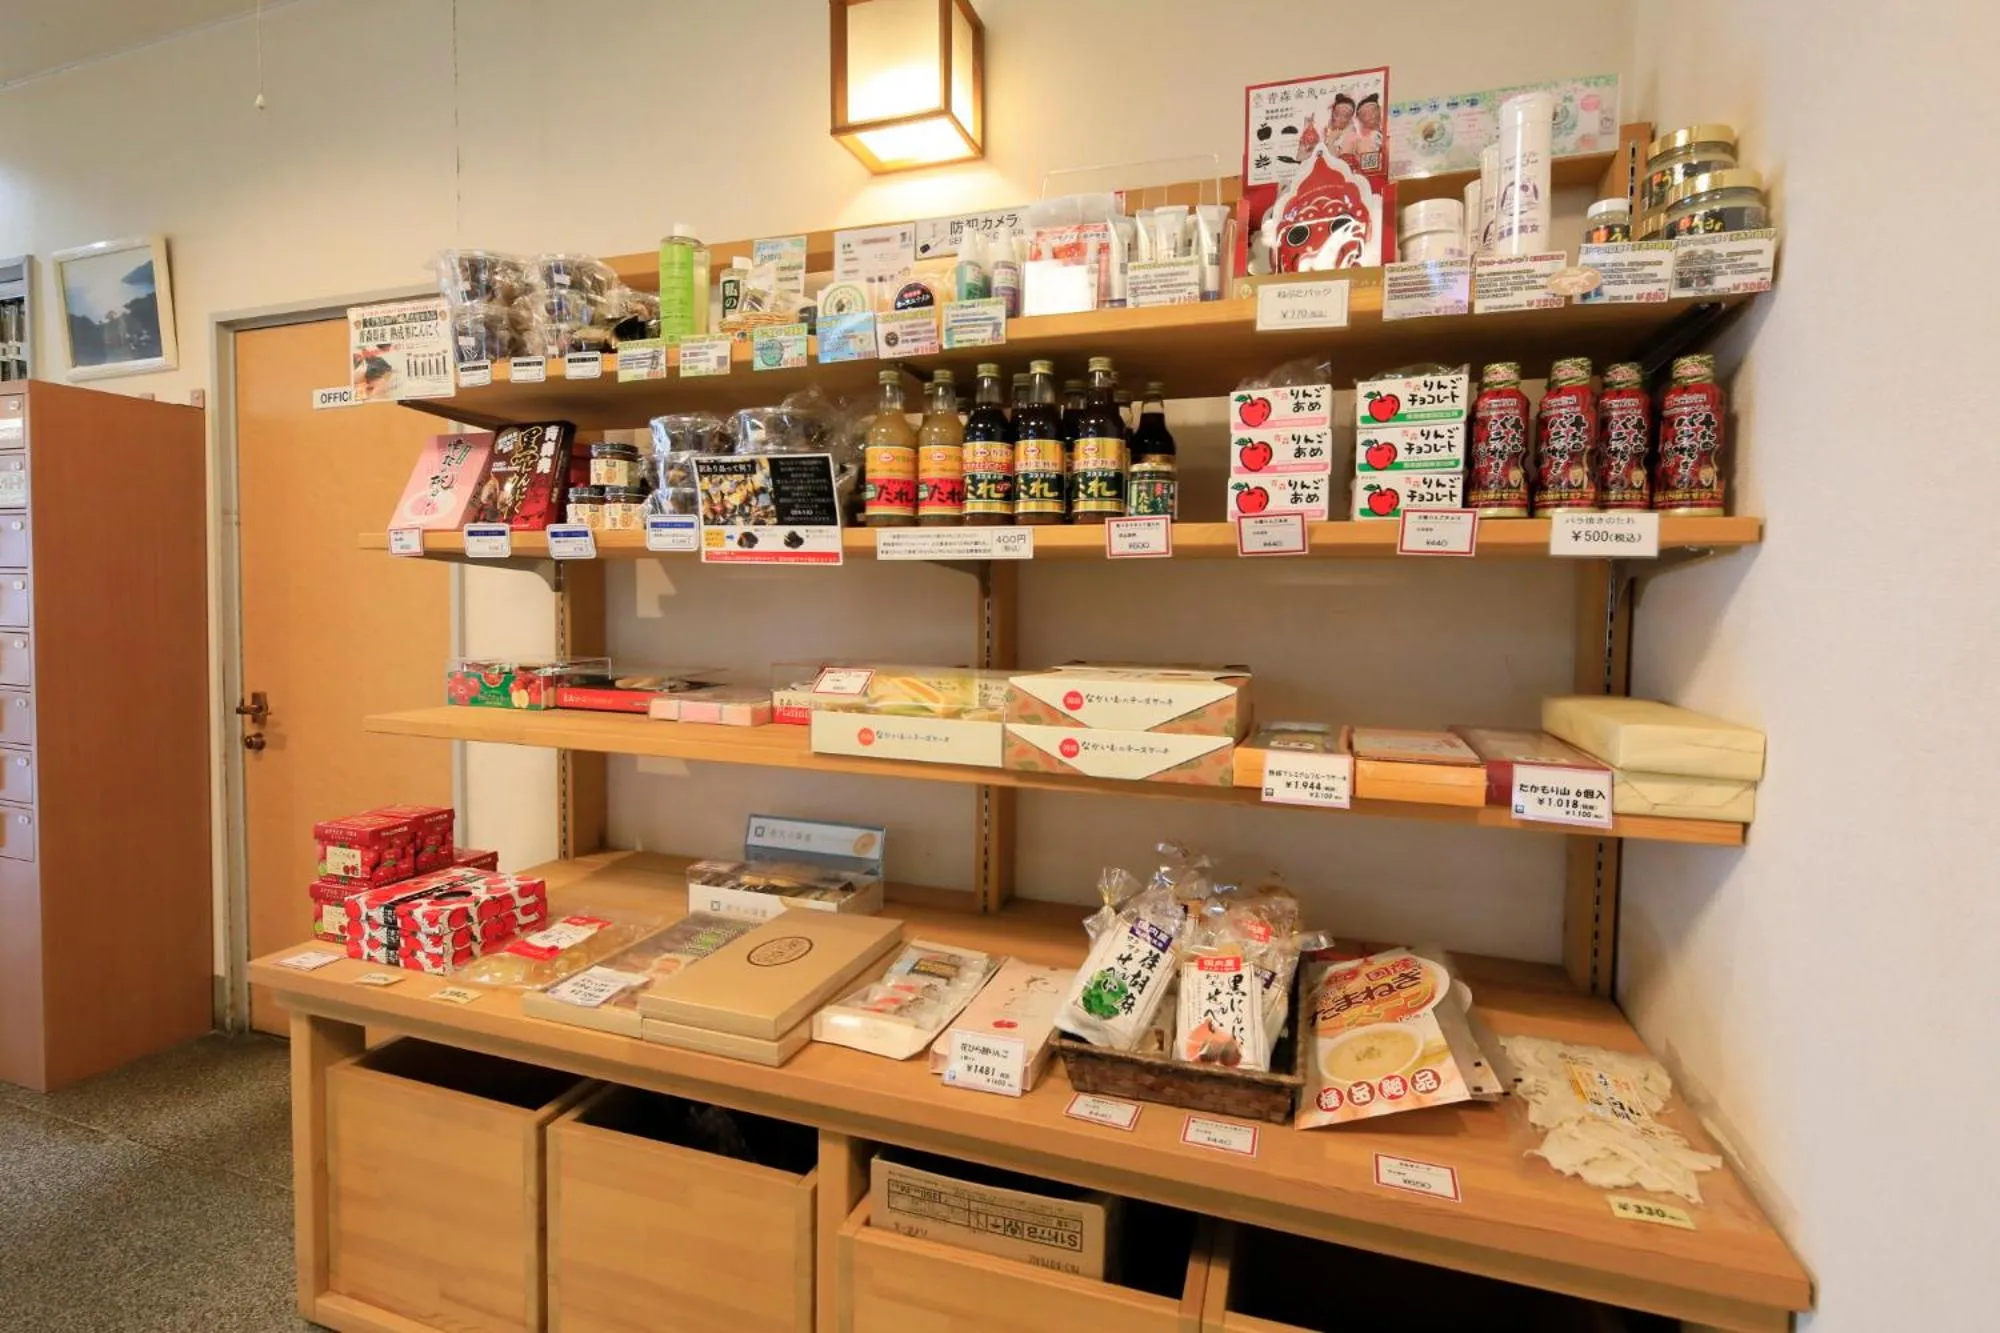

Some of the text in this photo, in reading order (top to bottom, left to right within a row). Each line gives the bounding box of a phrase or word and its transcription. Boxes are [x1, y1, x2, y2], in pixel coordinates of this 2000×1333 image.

[950, 213, 1019, 236] 防犯カメラ
[1424, 377, 1463, 392] りんご
[320, 391, 352, 405] OFFIC
[1290, 386, 1326, 399] りんご
[1408, 390, 1460, 406] チョコレート
[1292, 401, 1322, 413] あめ
[1292, 432, 1328, 445] りんご
[1420, 427, 1460, 441] りんご
[1293, 446, 1324, 458] あめ
[1404, 441, 1456, 455] チョコレート
[1288, 478, 1324, 491] りんご
[1422, 476, 1461, 489] りんご
[1290, 492, 1320, 504] あめ
[1406, 489, 1458, 503] チョコレート
[996, 534, 1026, 545] 400円
[1310, 967, 1422, 1028] たまねぎ
